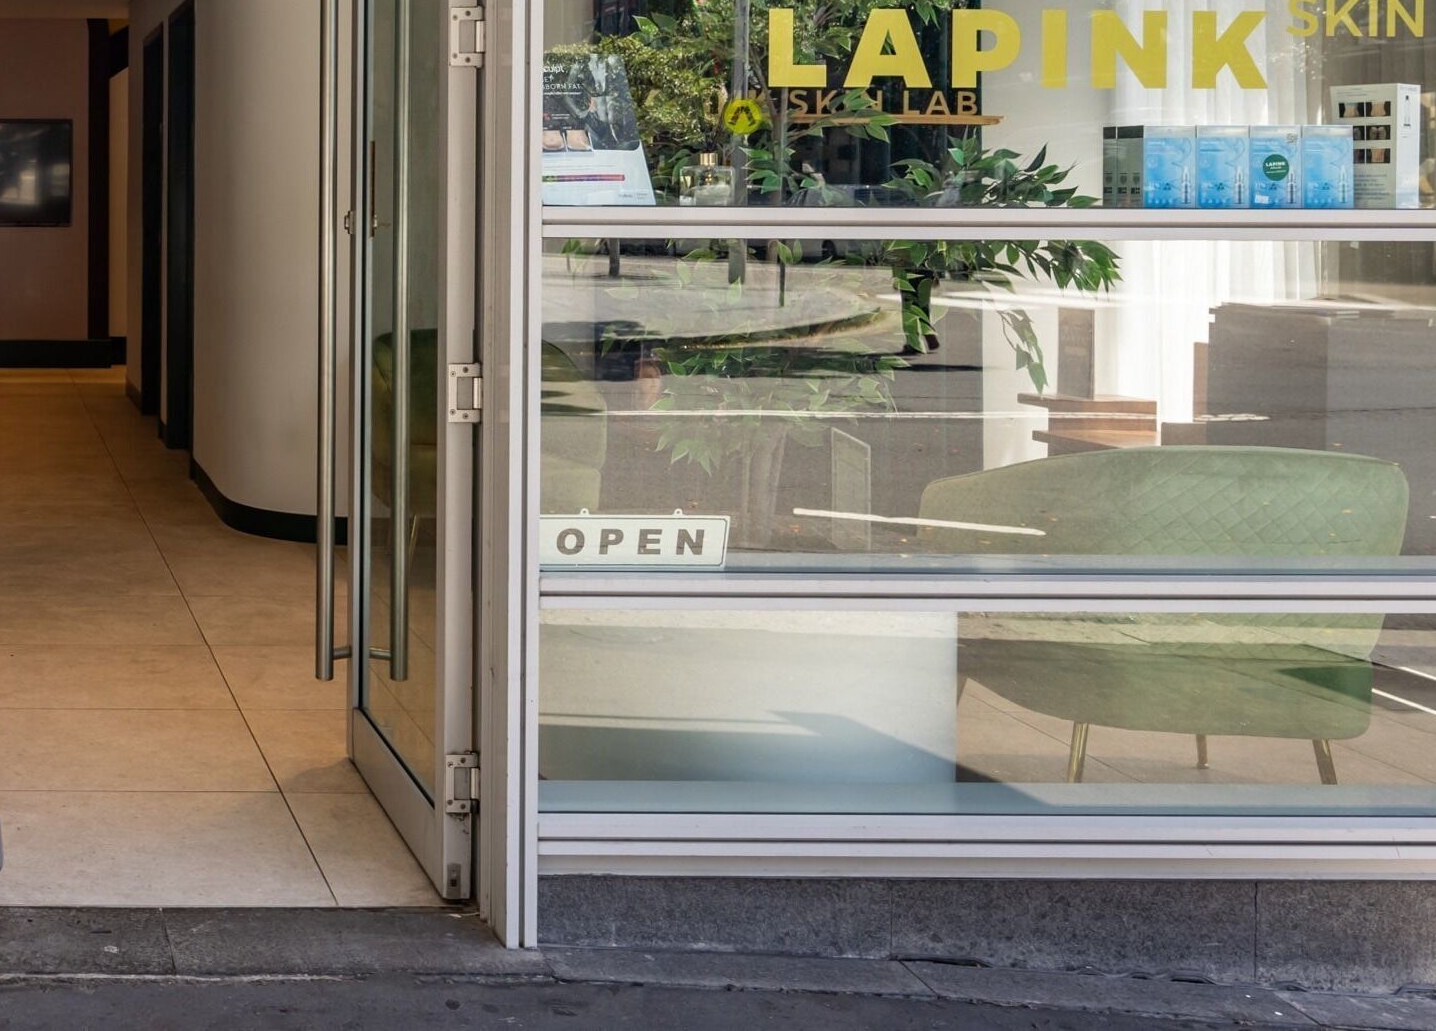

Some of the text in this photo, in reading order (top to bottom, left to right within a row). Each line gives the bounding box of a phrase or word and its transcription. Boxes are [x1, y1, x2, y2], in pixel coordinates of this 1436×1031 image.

[768, 7, 1268, 89] LAPINK
[902, 90, 978, 116] LAB
[556, 528, 705, 555] OPEN
